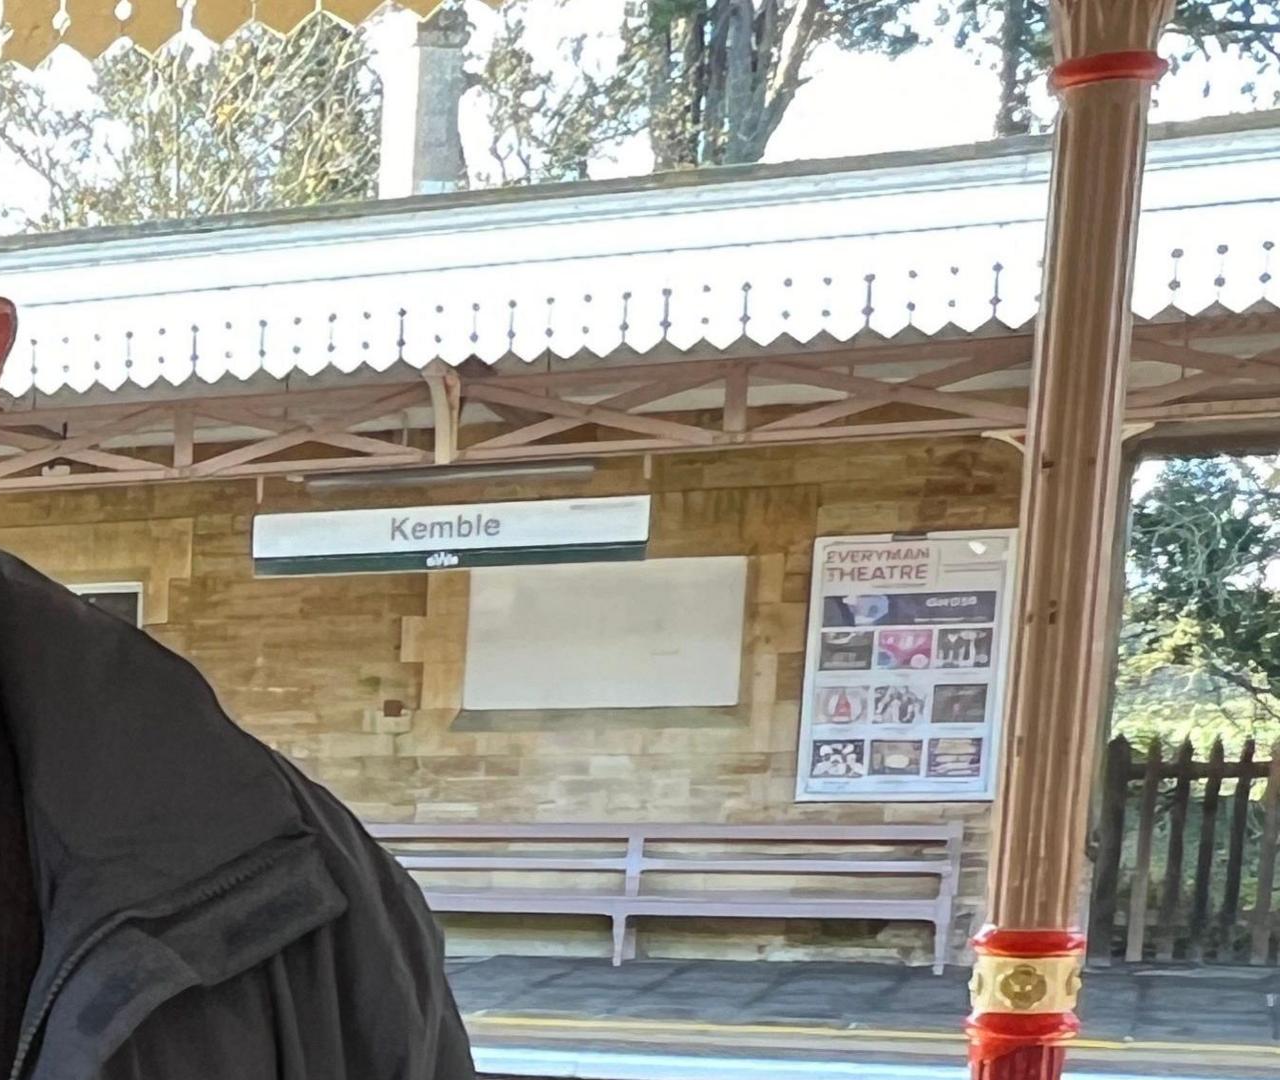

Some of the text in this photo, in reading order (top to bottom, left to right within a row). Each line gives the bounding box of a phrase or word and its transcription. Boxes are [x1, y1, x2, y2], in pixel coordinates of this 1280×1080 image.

[390, 514, 501, 541] Kemble
[827, 548, 930, 563] EVERYMAN
[826, 563, 928, 582] THEATRE
